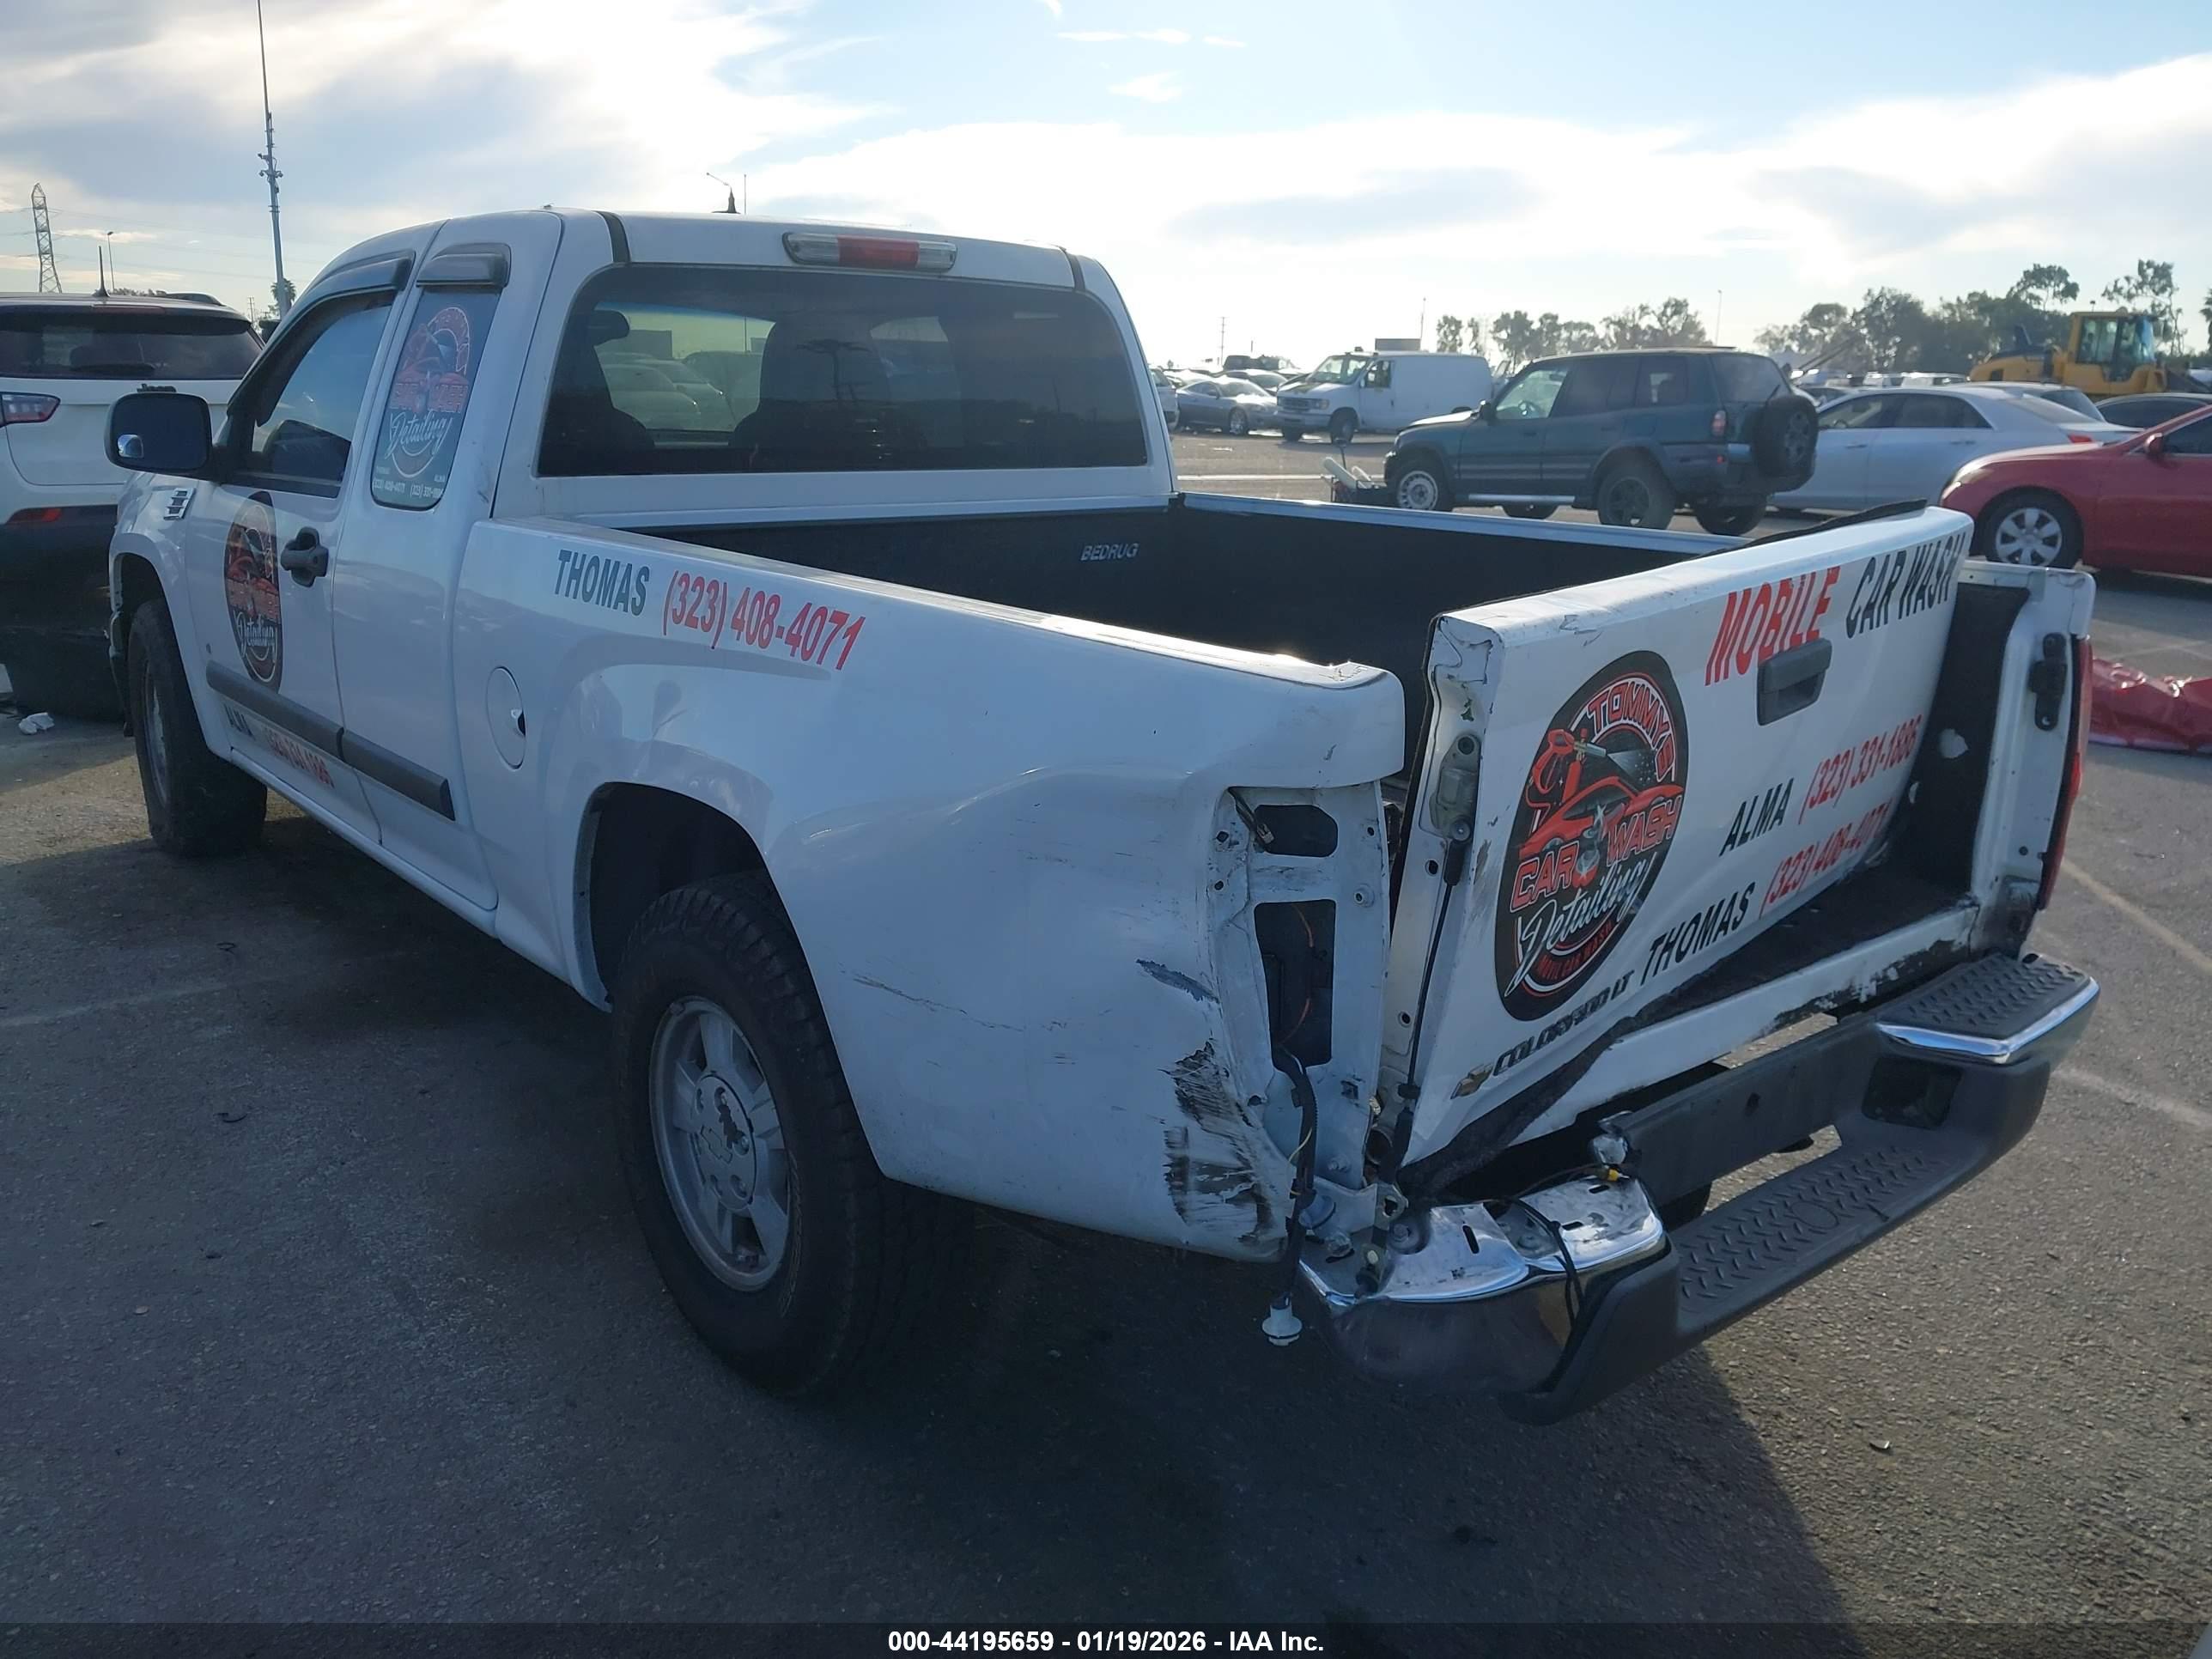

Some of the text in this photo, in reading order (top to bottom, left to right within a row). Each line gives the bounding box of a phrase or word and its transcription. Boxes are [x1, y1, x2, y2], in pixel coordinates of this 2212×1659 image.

[385, 409, 447, 459] Detailing
[1080, 542, 1139, 562] BEDRUG
[555, 549, 866, 671] THOMAS (323) 408-4071
[1705, 532, 1967, 686] MOBILE CAR WASH
[1510, 795, 1683, 912] CAR WASH
[1718, 776, 1796, 858] ALMA
[1798, 746, 1856, 825] (323)
[1504, 863, 1647, 997] Detailing
[1608, 969, 1635, 1001] LT
[1640, 881, 1757, 987] THOMAS
